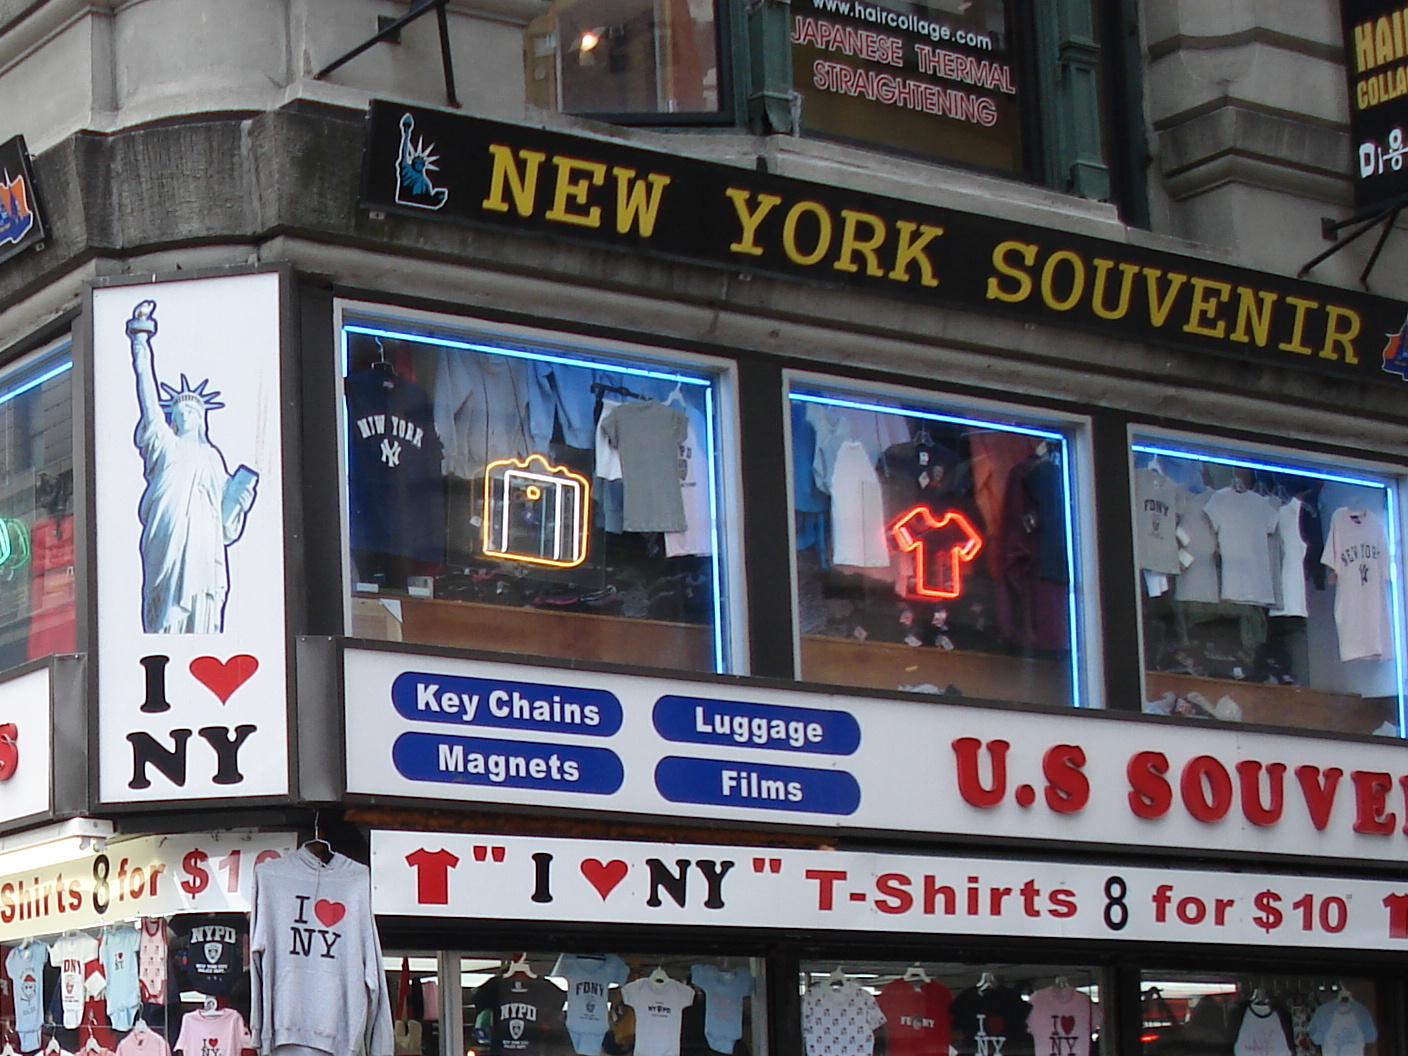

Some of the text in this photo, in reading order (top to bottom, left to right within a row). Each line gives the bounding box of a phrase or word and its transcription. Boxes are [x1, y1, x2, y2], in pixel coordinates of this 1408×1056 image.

[791, 16, 1016, 94] JAPANESE THERMAL
[813, 60, 998, 127] STRAIGHTENING
[1357, 66, 1408, 110] COLLA
[482, 143, 1362, 365] NEW YORK SOUVENIR
[1143, 499, 1169, 517] FDNY
[139, 654, 172, 714] I
[416, 683, 600, 728] Key Chains
[695, 705, 823, 746] Luggage
[126, 724, 258, 790] NY
[438, 744, 580, 782] Magnets
[721, 769, 803, 802] Films
[951, 736, 1408, 837] U.S SOUVE
[93, 854, 110, 915] 8
[118, 857, 166, 902] for
[531, 852, 1349, 935] I NY T-Shirts 8 for $10
[294, 895, 309, 924] I
[190, 925, 237, 944] NYPD
[288, 926, 342, 960] NY
[575, 981, 604, 998] FDNY
[500, 1003, 537, 1021] NYPD
[976, 1014, 986, 1035] I
[1050, 1015, 1060, 1036] I
[1049, 1036, 1078, 1056] NY
